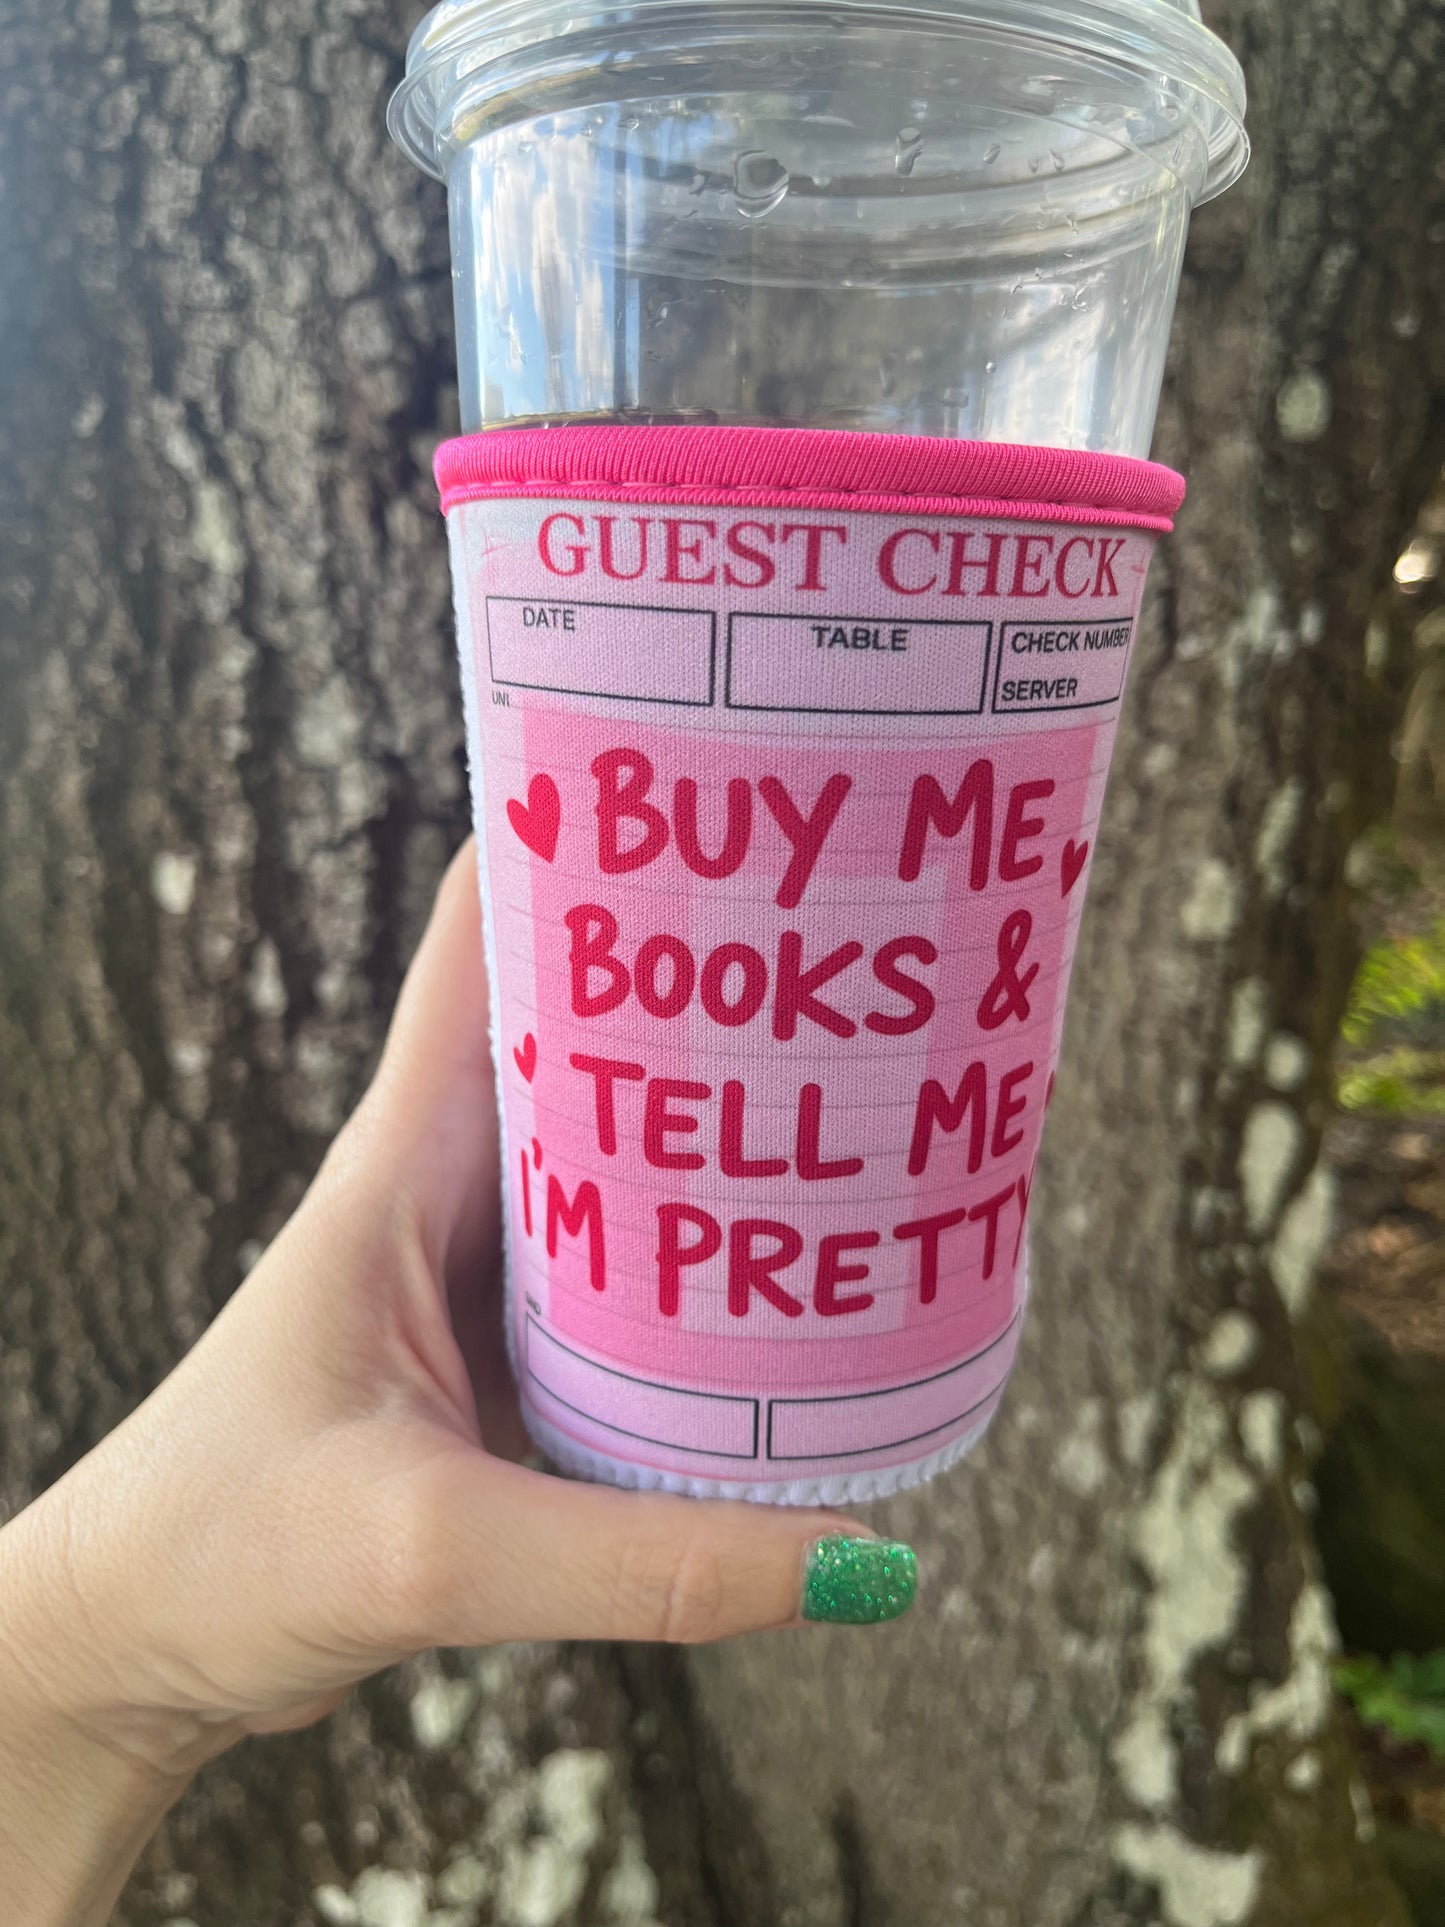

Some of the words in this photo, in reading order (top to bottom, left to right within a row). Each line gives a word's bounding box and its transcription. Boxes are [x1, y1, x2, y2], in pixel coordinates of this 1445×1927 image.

[538, 512, 848, 592] GUEST
[876, 527, 1127, 599] CHECK
[522, 606, 576, 632] DATE
[811, 624, 909, 652] TABLE
[1011, 629, 1079, 654] CHECK
[1083, 627, 1130, 650] NUMBER
[1001, 678, 1078, 700] SERVER
[591, 747, 853, 909] BUY
[898, 758, 1055, 892] ME
[564, 904, 939, 1042] BOOKS
[976, 909, 1040, 1031] &
[569, 1052, 864, 1180] TELL
[907, 1061, 1034, 1176] ME
[521, 1137, 606, 1292] I'M
